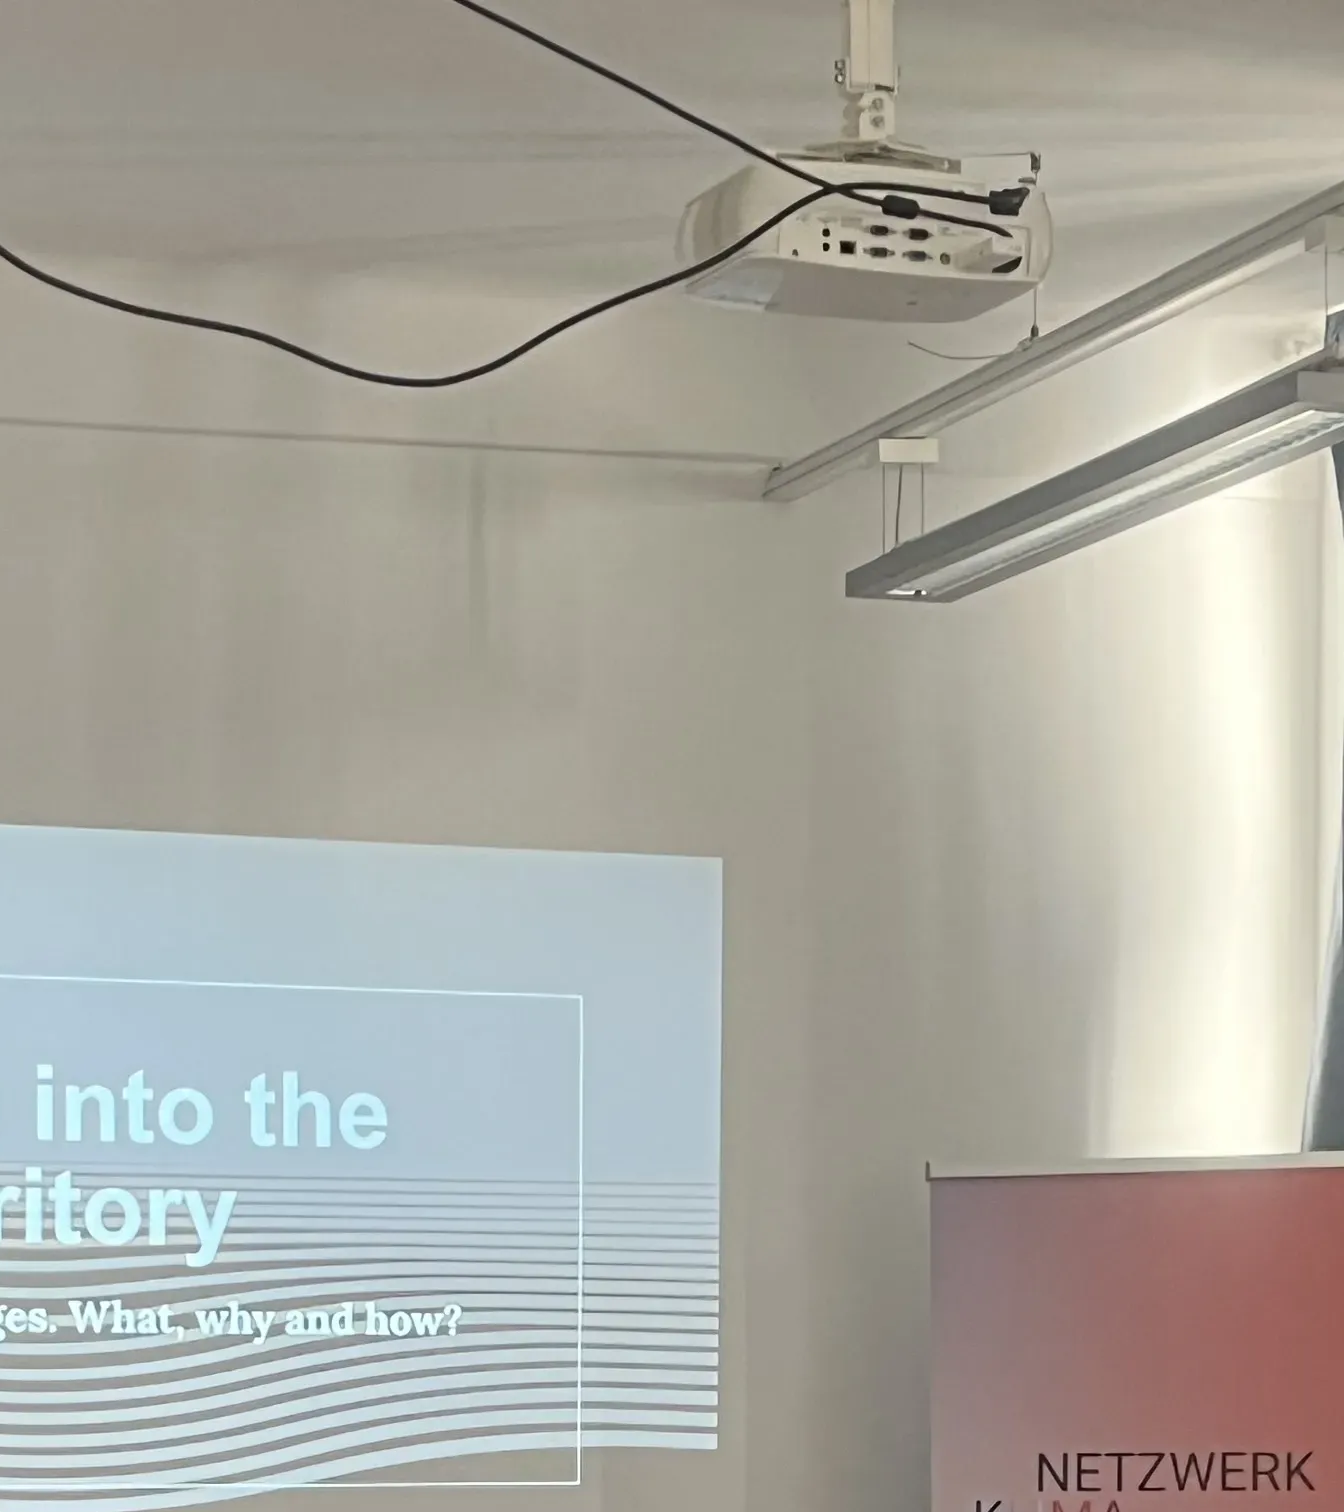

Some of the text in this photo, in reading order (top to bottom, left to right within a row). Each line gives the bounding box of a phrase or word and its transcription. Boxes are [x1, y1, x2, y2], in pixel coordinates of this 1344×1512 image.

[36, 1064, 214, 1145] into
[244, 1070, 388, 1149] the
[68, 1299, 186, 1341] What,
[195, 1302, 276, 1344] why
[284, 1302, 355, 1336] and
[364, 1303, 462, 1337] how?
[1037, 1451, 1315, 1492] NETZWERK
